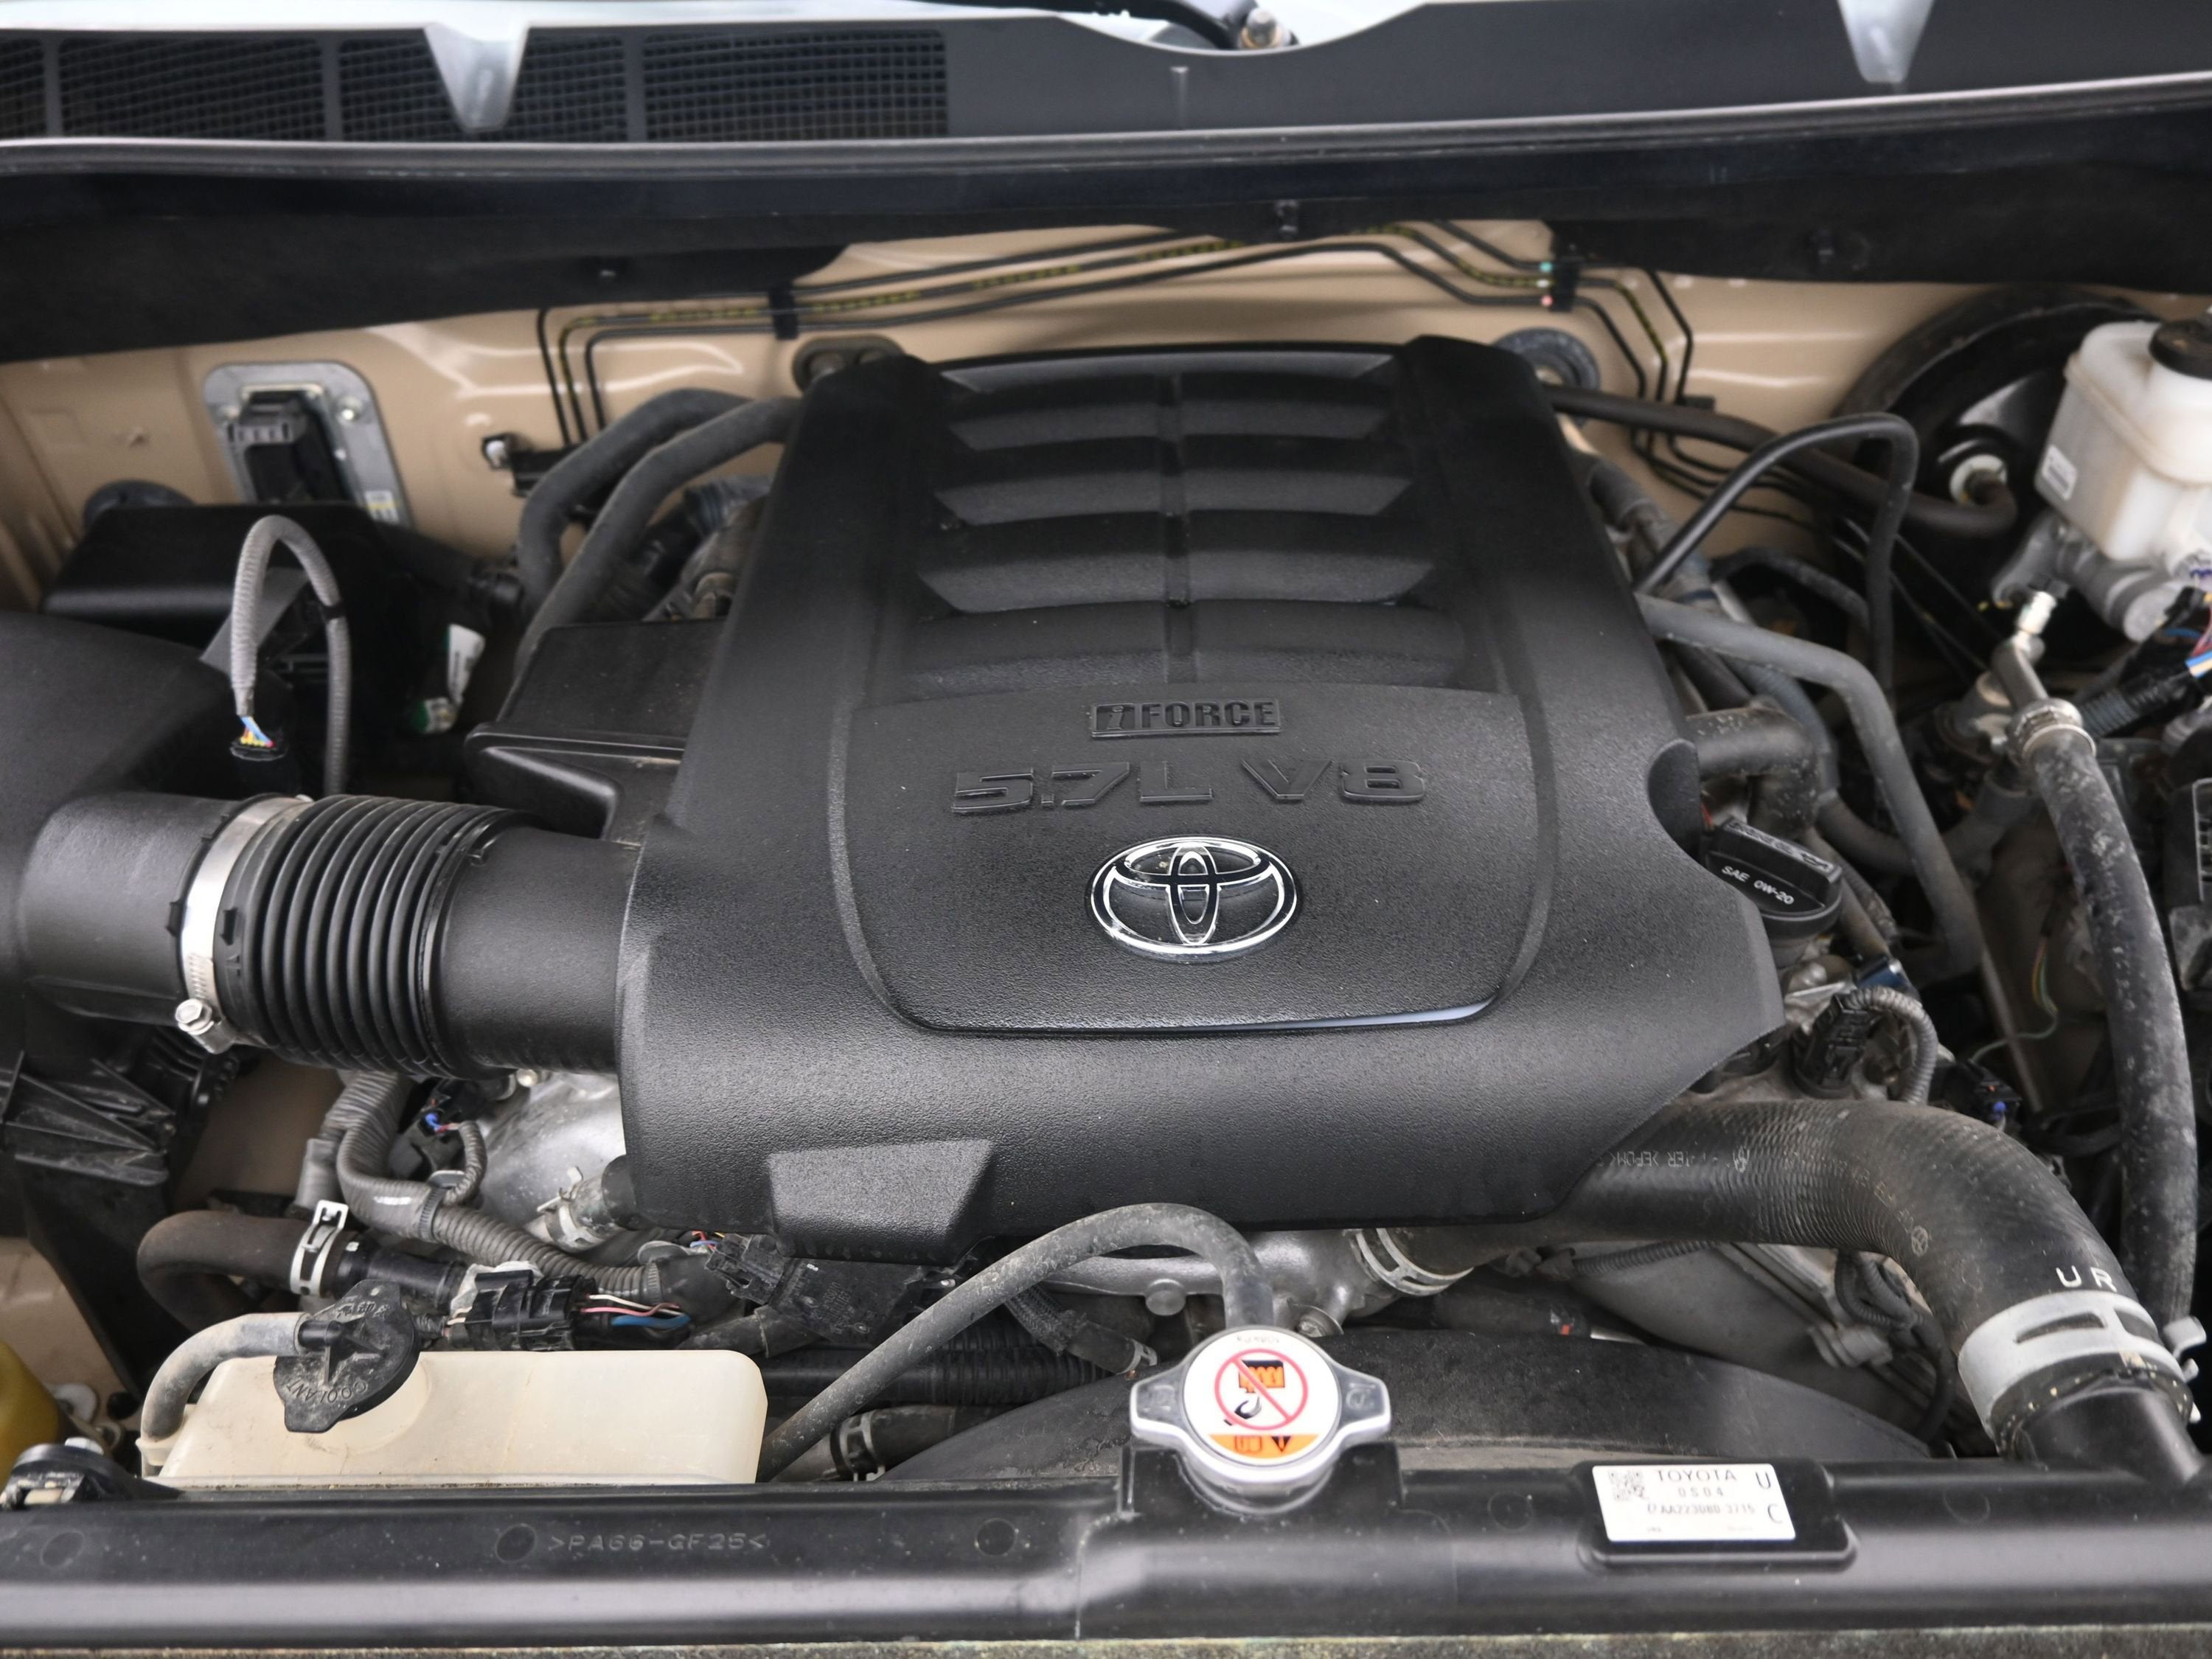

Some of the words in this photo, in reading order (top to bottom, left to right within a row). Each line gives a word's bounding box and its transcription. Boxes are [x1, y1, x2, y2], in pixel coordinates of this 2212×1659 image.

[952, 761, 1214, 814] 5.7L
[1242, 759, 1427, 801] V8
[1721, 865, 1750, 883] SAE
[1753, 880, 1795, 905] 0W-20
[286, 1377, 369, 1403] COOLANT
[1657, 1468, 1739, 1482] TOYOTA
[1754, 1470, 1772, 1490] U
[1767, 1503, 1784, 1524] C
